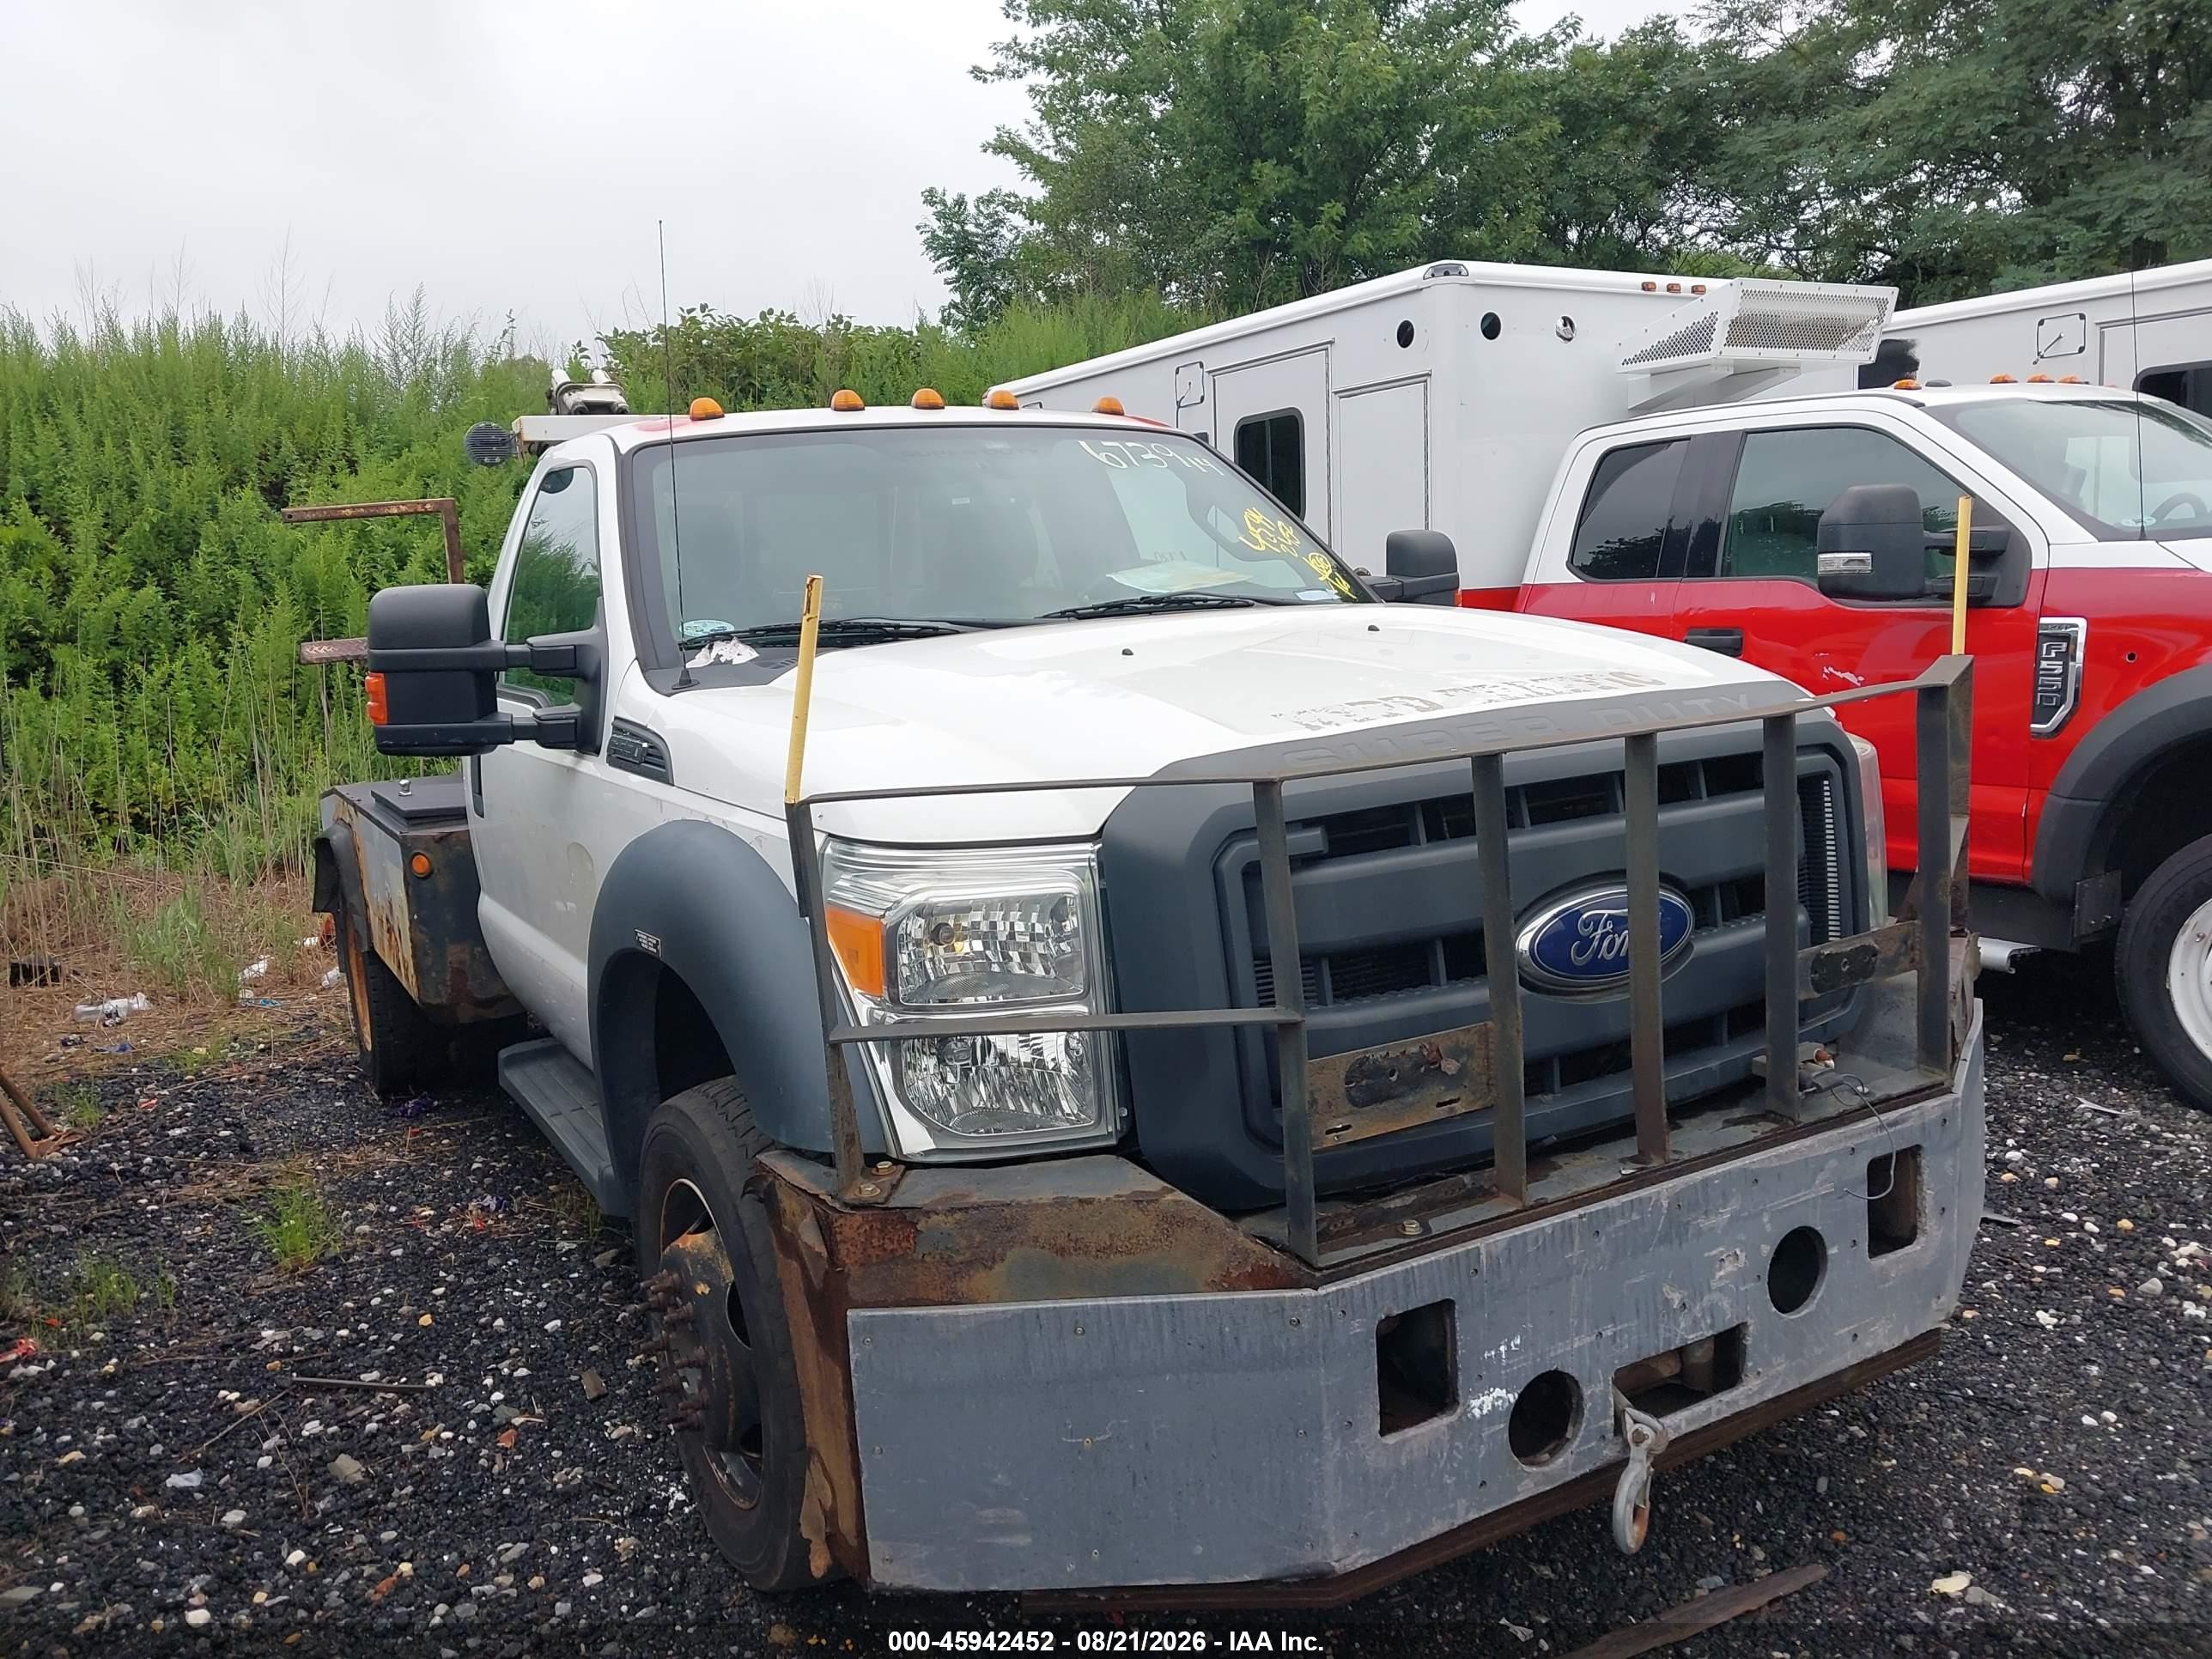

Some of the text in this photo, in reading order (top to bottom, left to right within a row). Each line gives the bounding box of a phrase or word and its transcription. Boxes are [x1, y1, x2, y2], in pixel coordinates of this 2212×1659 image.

[1283, 693, 1750, 765] SUPER DUTY
[1571, 908, 1662, 967] For
